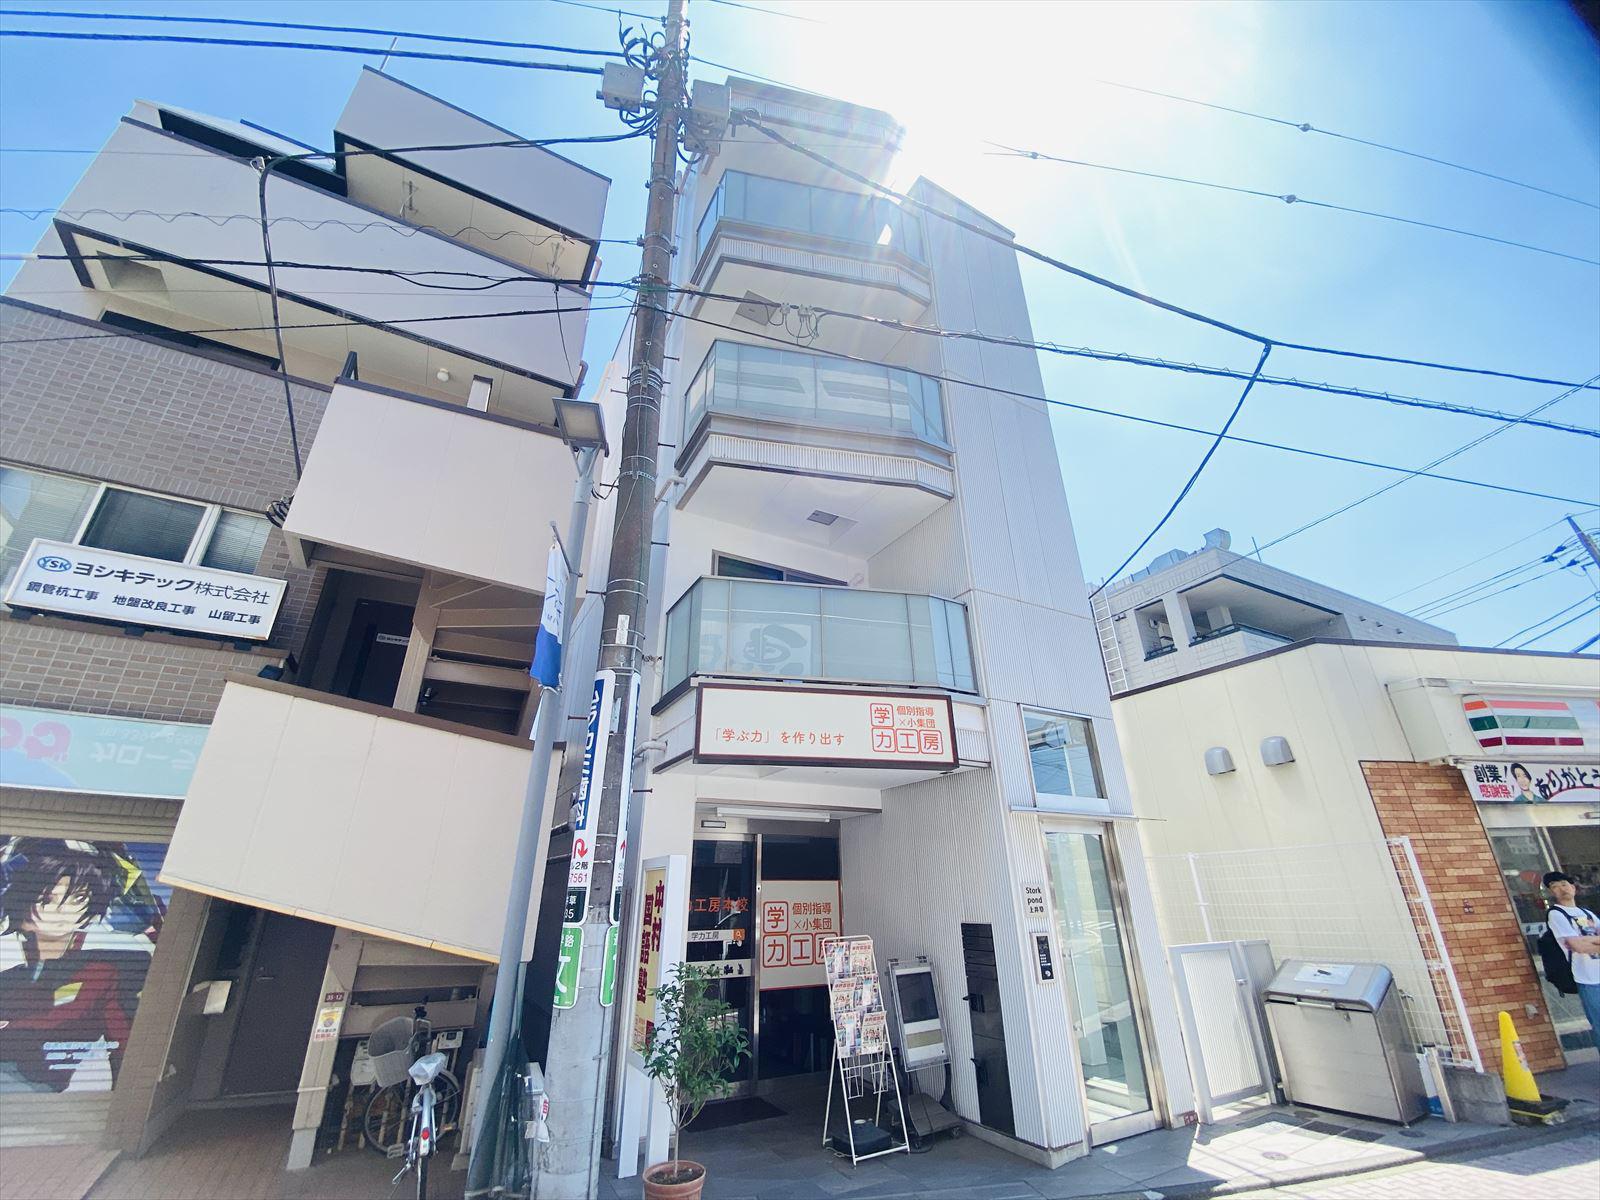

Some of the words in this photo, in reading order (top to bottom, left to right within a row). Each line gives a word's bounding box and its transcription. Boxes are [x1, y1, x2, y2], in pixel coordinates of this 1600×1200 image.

[37, 557, 72, 571] YSK
[73, 562, 271, 605] ヨシキテック株式会社
[26, 581, 100, 602] 鋼管杭工事
[112, 594, 196, 616] 地盤改良工事
[208, 609, 261, 625] 山留工事
[874, 707, 890, 724] 学
[896, 705, 935, 718] 個別指導
[875, 731, 940, 752] 力工房
[1025, 886, 1042, 894] Stork
[1027, 896, 1043, 905] pond
[652, 880, 665, 952] 中村
[792, 902, 832, 915] 個別指導
[767, 906, 785, 929] 学
[691, 931, 720, 940] 学力工房
